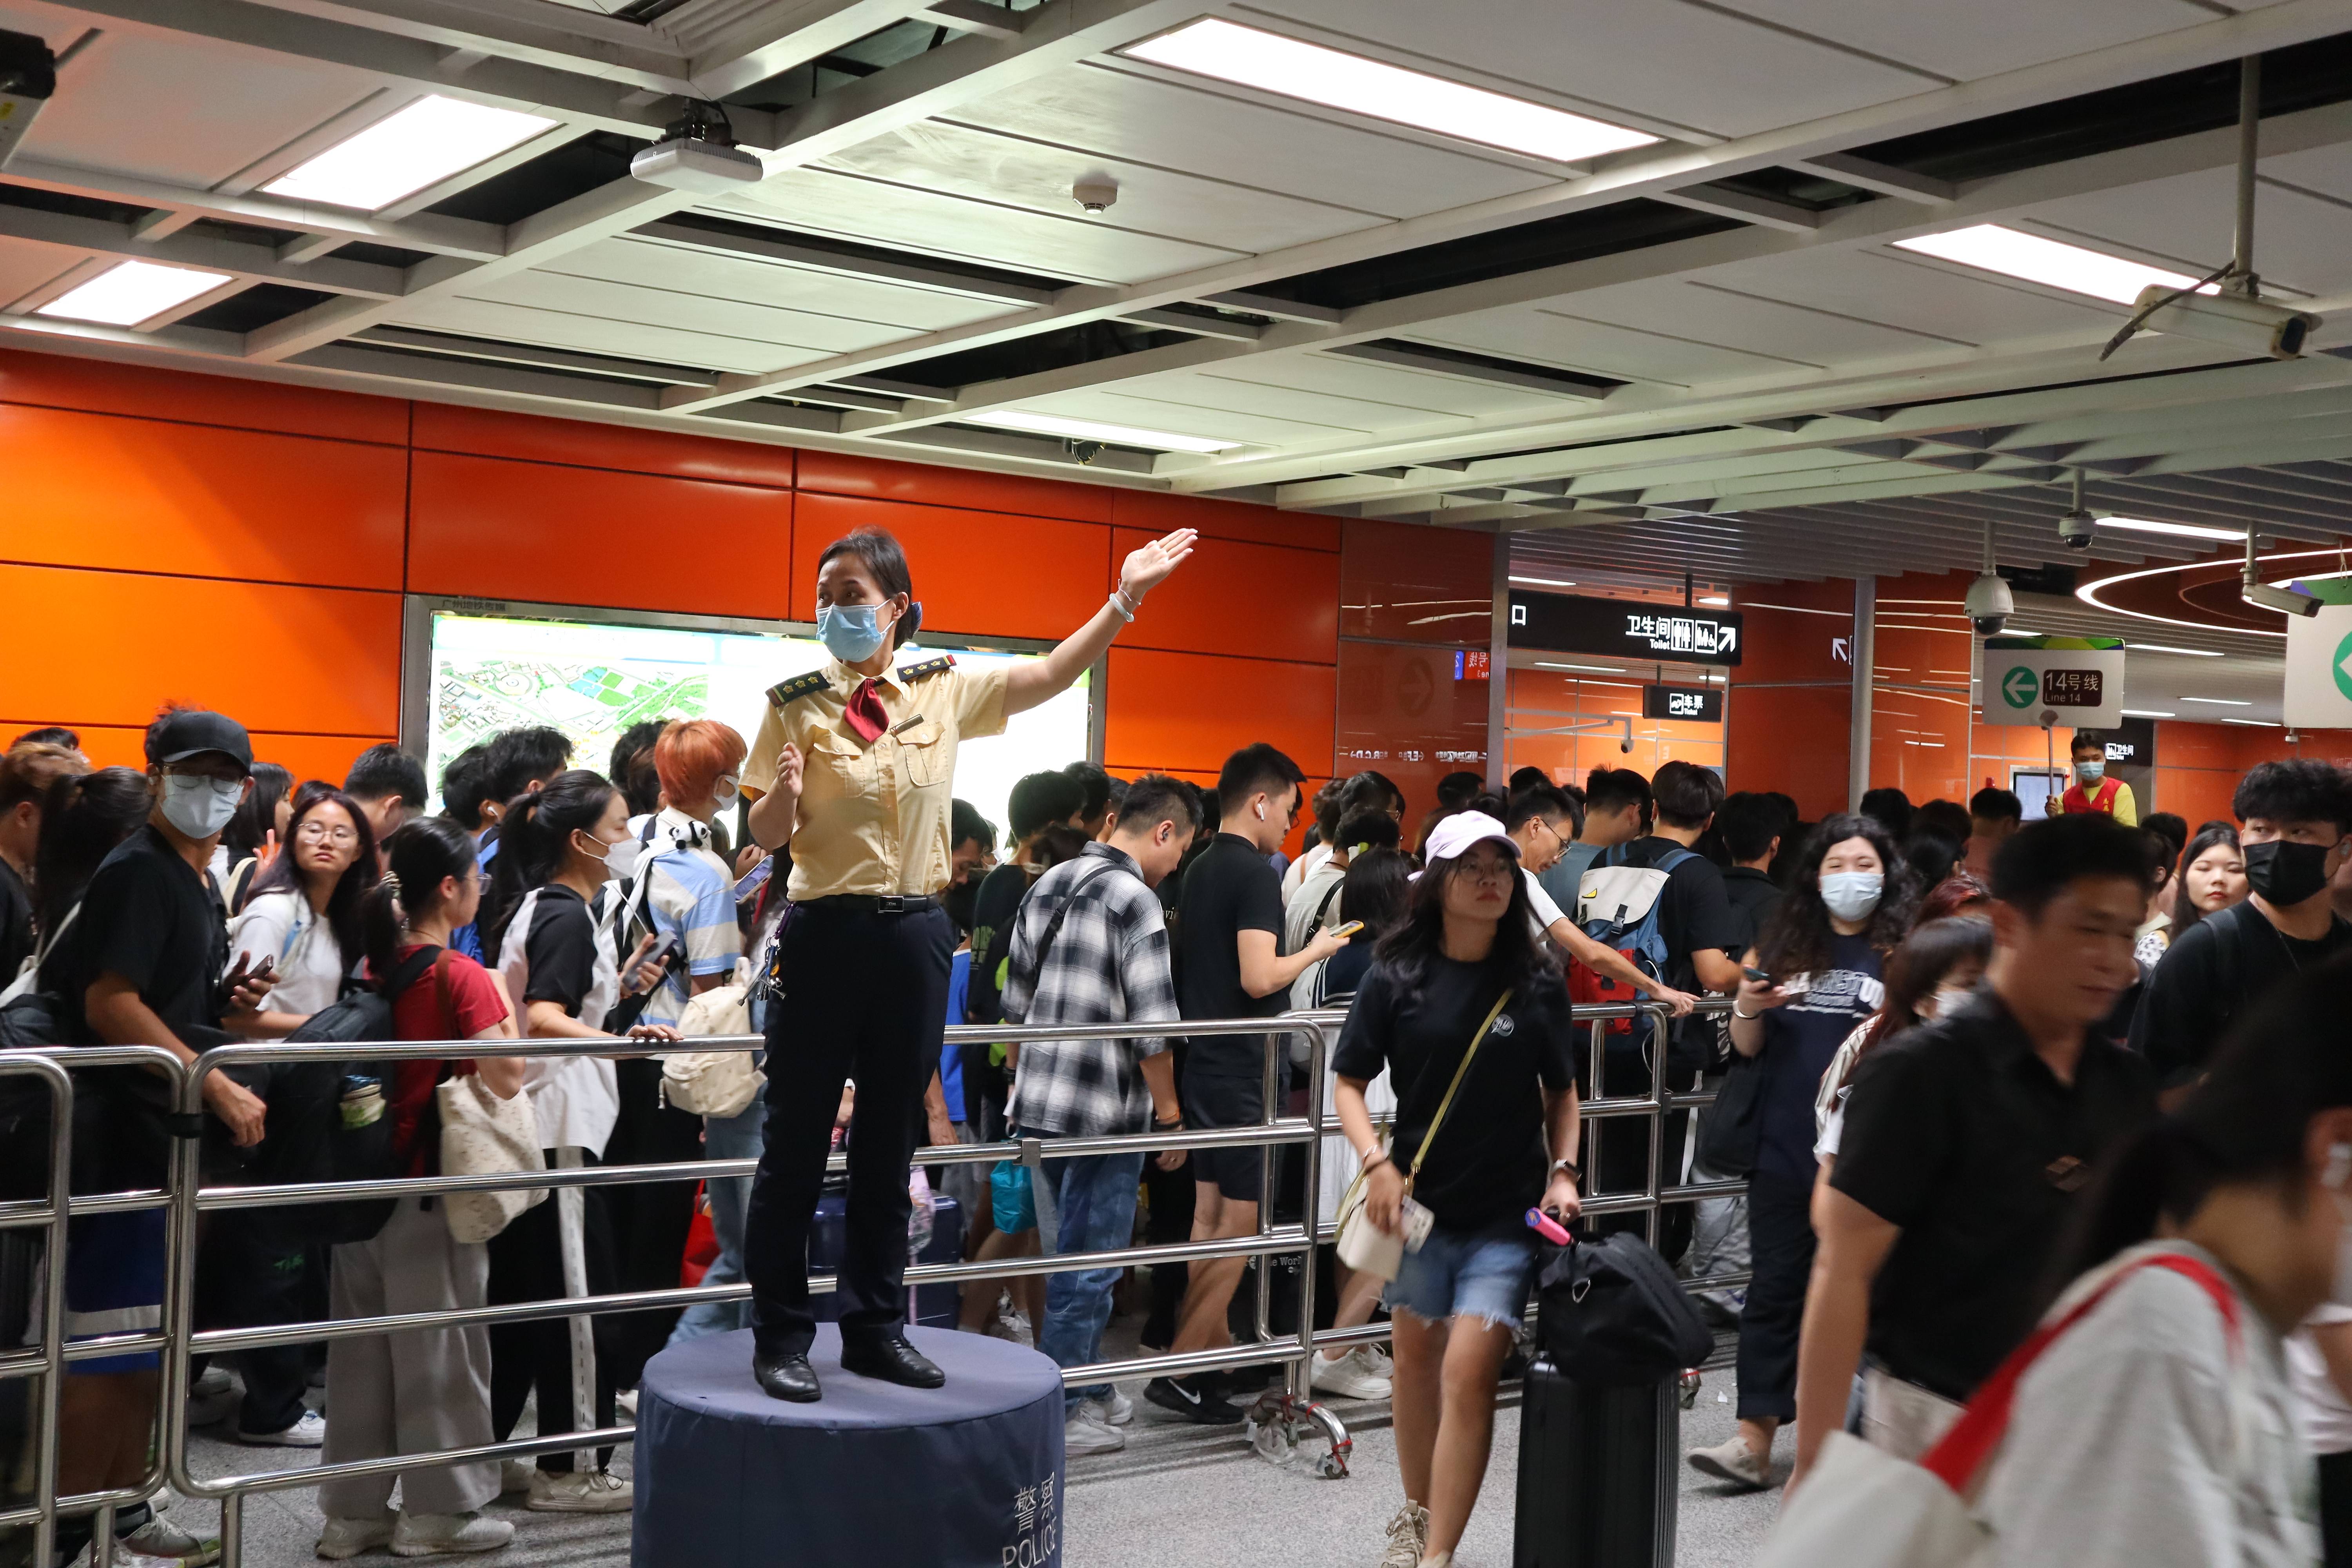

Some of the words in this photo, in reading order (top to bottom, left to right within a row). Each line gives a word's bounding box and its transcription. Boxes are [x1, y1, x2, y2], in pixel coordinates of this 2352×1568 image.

[442, 599, 506, 611] 广州地铁传媒
[1625, 615, 1671, 639] 卫生间
[1649, 639, 1670, 650] Toilet
[2046, 672, 2099, 691] 14号线
[1684, 694, 1704, 709] 车票
[2045, 693, 2066, 702] Line
[2069, 693, 2081, 703] 14
[2116, 744, 2134, 756] 卫生间
